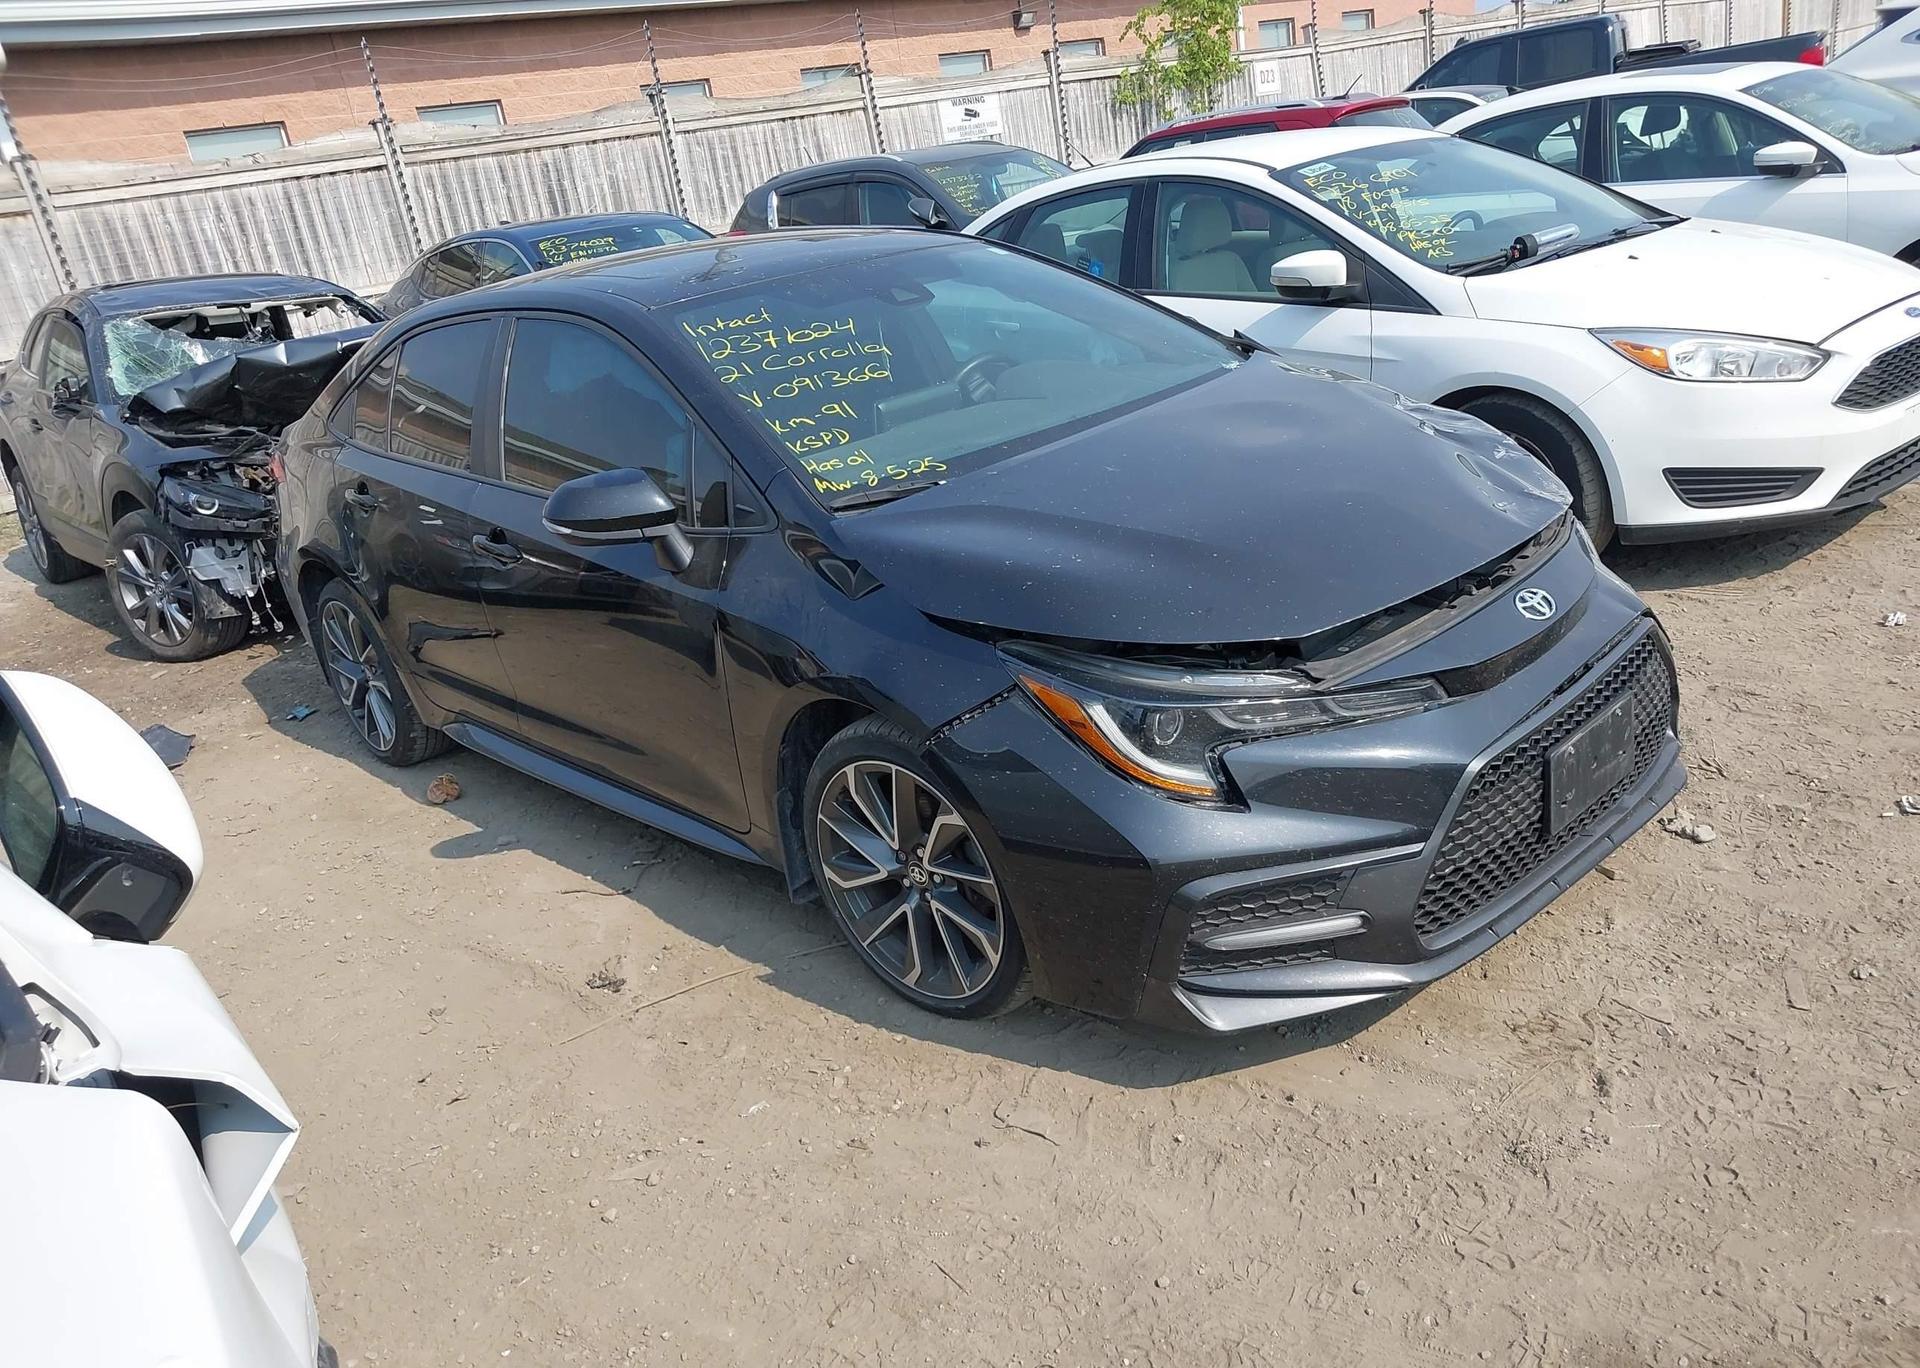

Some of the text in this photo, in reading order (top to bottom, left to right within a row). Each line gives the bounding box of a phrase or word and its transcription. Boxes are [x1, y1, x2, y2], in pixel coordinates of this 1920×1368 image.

[951, 95, 986, 107] WARNING
[1304, 171, 1347, 187] ECO
[538, 237, 568, 250] ECO
[570, 246, 619, 259] ENVISTA
[683, 307, 773, 337] Intact
[696, 318, 856, 363] 12371024
[714, 342, 893, 384] 21 Corrolla
